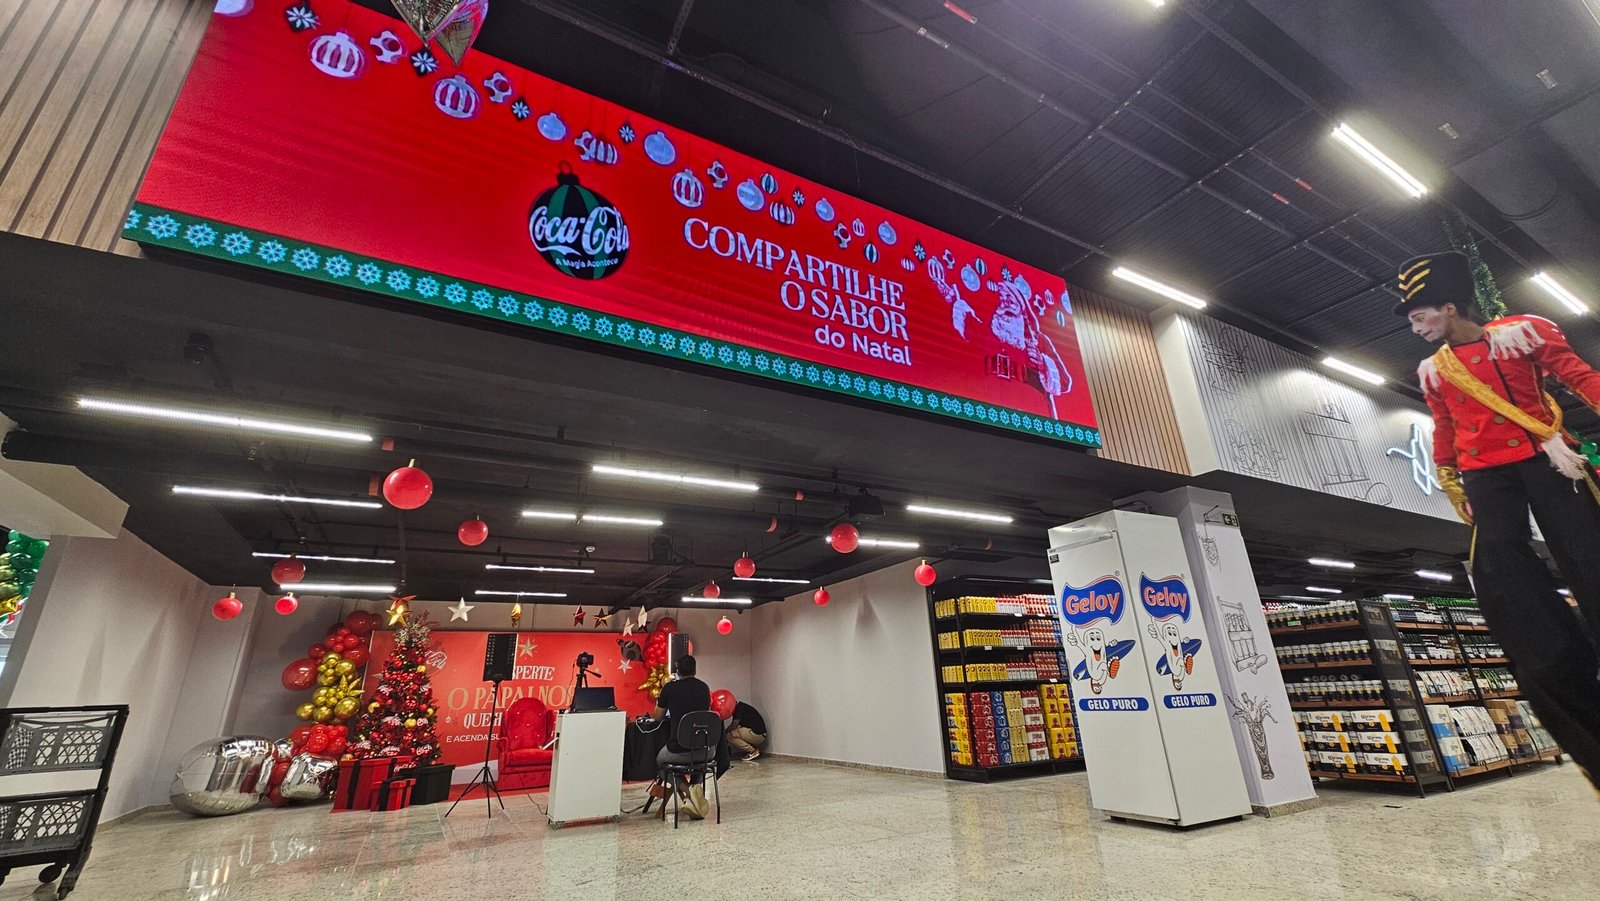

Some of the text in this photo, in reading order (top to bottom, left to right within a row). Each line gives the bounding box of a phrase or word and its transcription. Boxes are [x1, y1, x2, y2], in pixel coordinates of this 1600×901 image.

[529, 206, 630, 256] Coca-Cola
[684, 217, 905, 310] COMPARTILHE
[781, 280, 909, 341] O SABOR
[815, 326, 911, 366] do Natal
[1065, 591, 1121, 614] Geloy
[1144, 586, 1187, 613] Geloy
[447, 687, 468, 710] O
[538, 684, 575, 707] NOE
[1087, 698, 1139, 710] GELO PURO
[1171, 695, 1210, 708] GELO PURO
[463, 712, 492, 729] QUE
[446, 735, 452, 743] E
[453, 734, 489, 743] ACENDA
